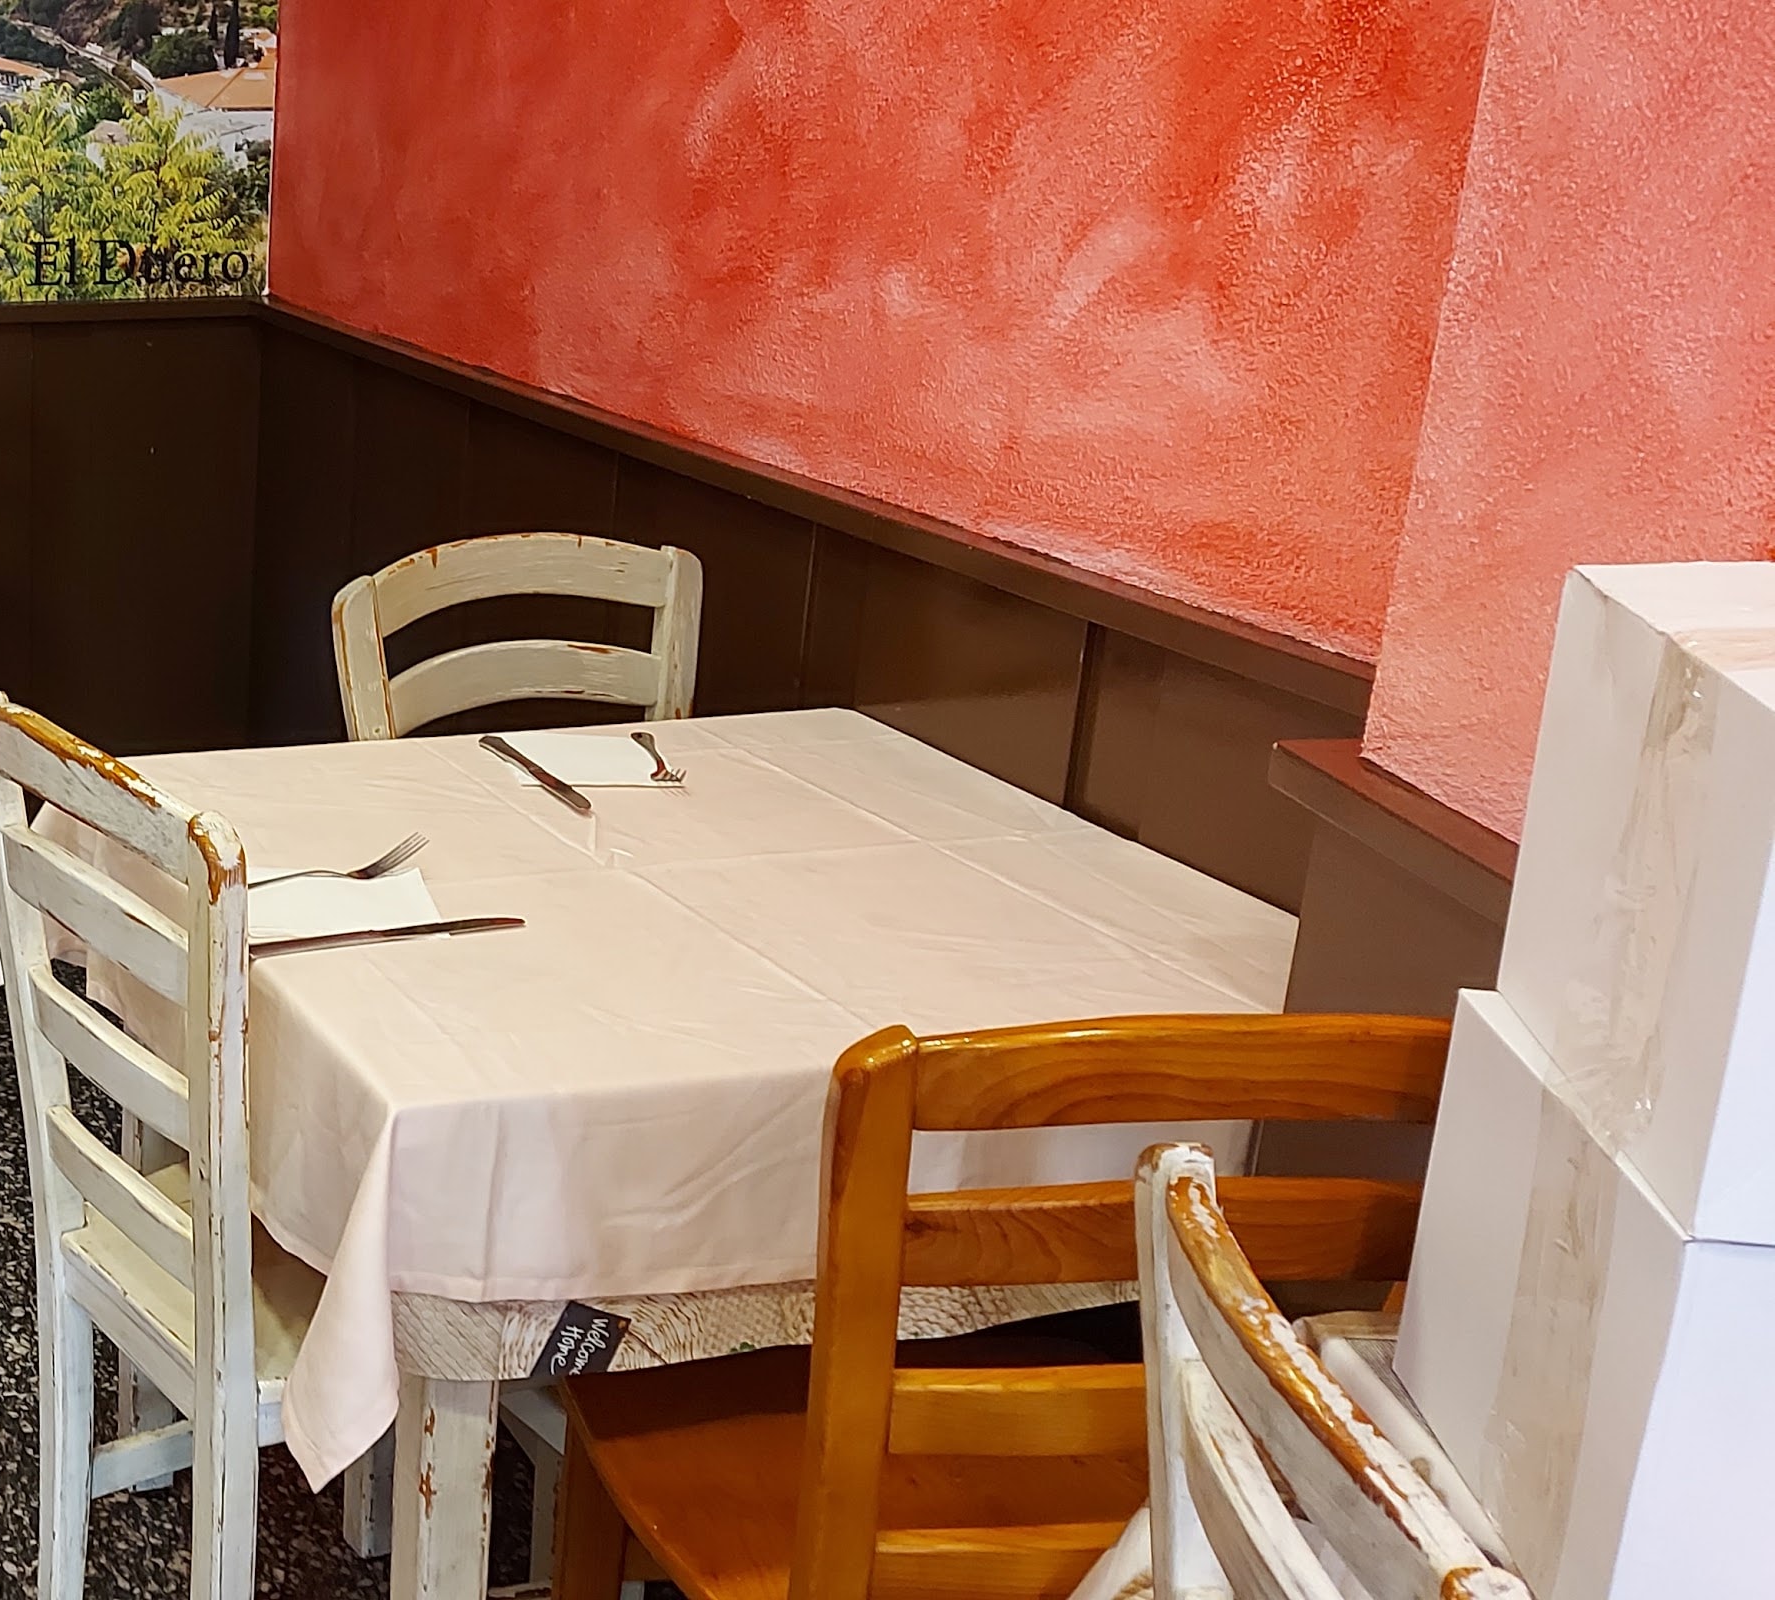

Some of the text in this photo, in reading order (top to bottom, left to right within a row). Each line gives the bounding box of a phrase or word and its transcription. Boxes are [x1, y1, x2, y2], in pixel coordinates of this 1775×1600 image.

[26, 237, 249, 287] El Duero
[550, 1325, 585, 1376] Home
